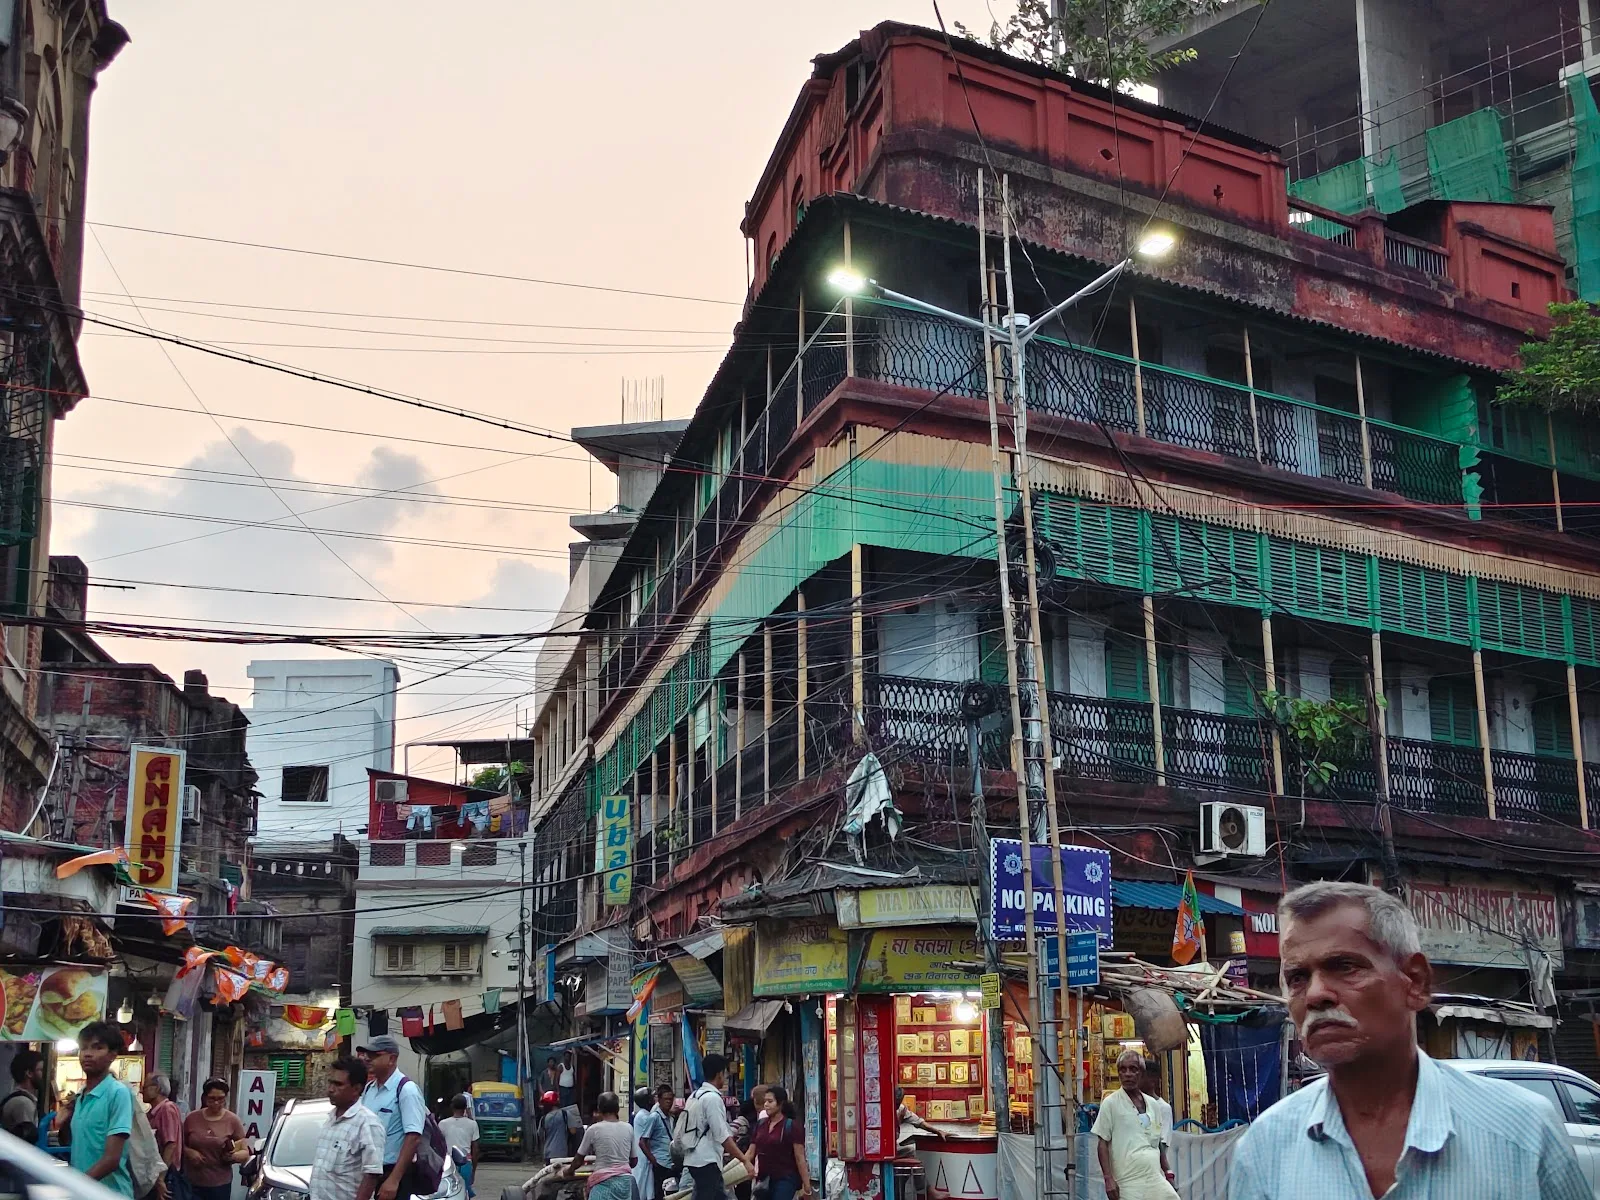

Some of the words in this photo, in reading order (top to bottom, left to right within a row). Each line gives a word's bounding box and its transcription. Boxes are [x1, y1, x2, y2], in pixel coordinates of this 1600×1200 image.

[139, 756, 172, 884] ANAND
[129, 889, 144, 899] PA
[877, 891, 902, 912] MA
[907, 888, 971, 911] MANASA
[1002, 888, 1026, 910] NO
[1033, 891, 1106, 917] PAKING
[1015, 924, 1042, 932] KOLTA
[891, 938, 909, 956] মা
[913, 938, 954, 956] মনসা
